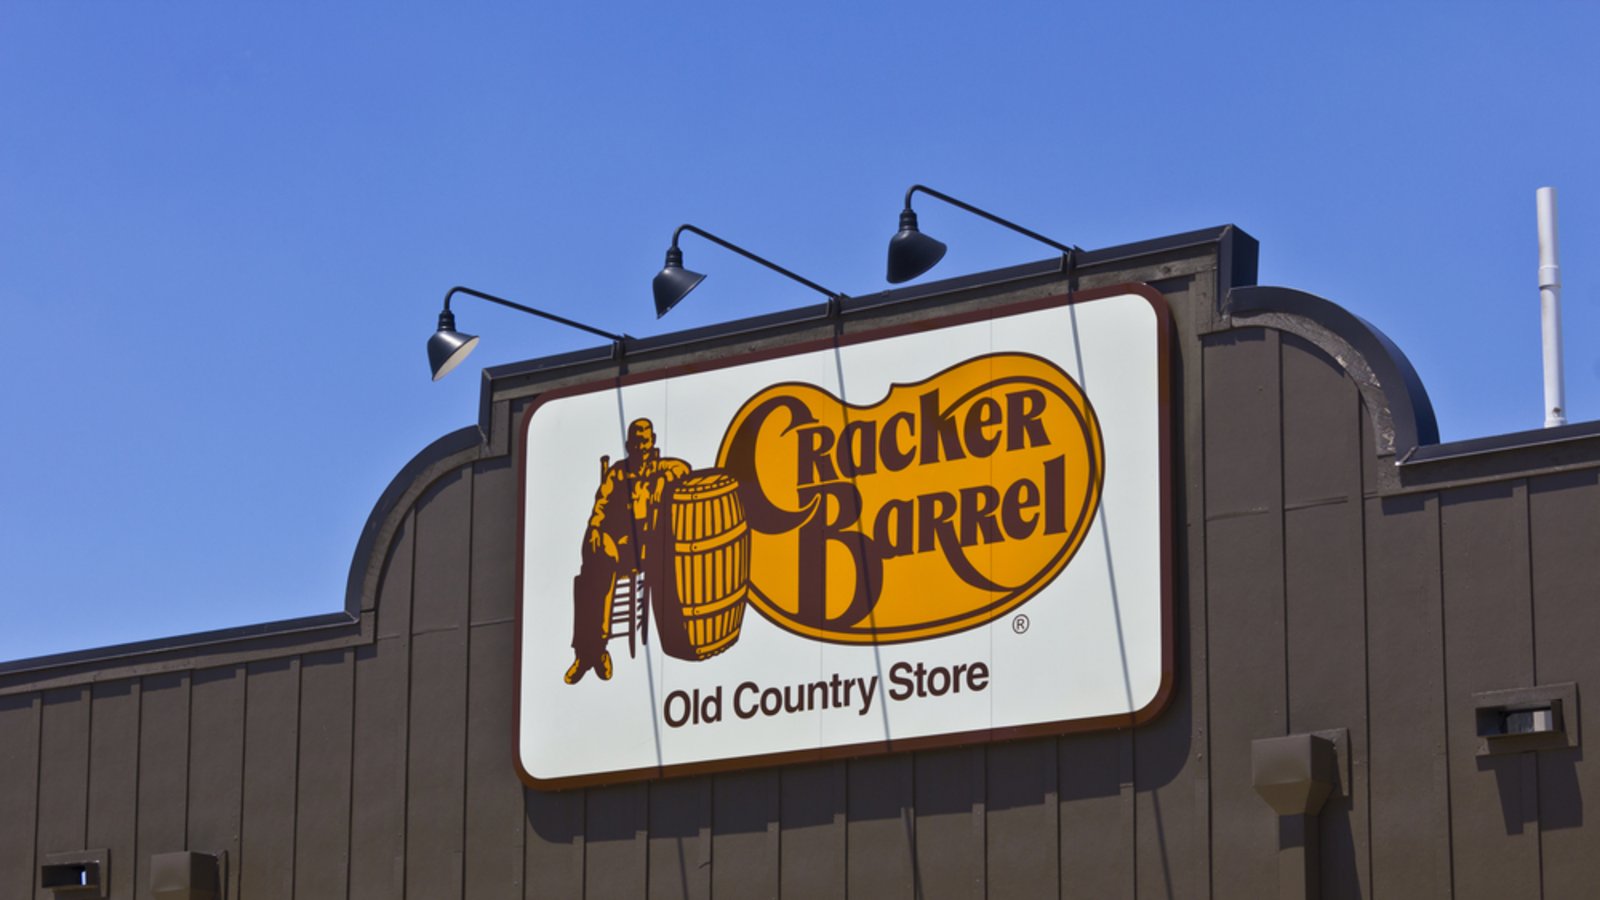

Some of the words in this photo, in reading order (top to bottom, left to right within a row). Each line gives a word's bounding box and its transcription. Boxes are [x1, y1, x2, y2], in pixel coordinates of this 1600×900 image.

[663, 686, 722, 728] Old
[733, 674, 878, 719] Country
[888, 661, 989, 701] Store
